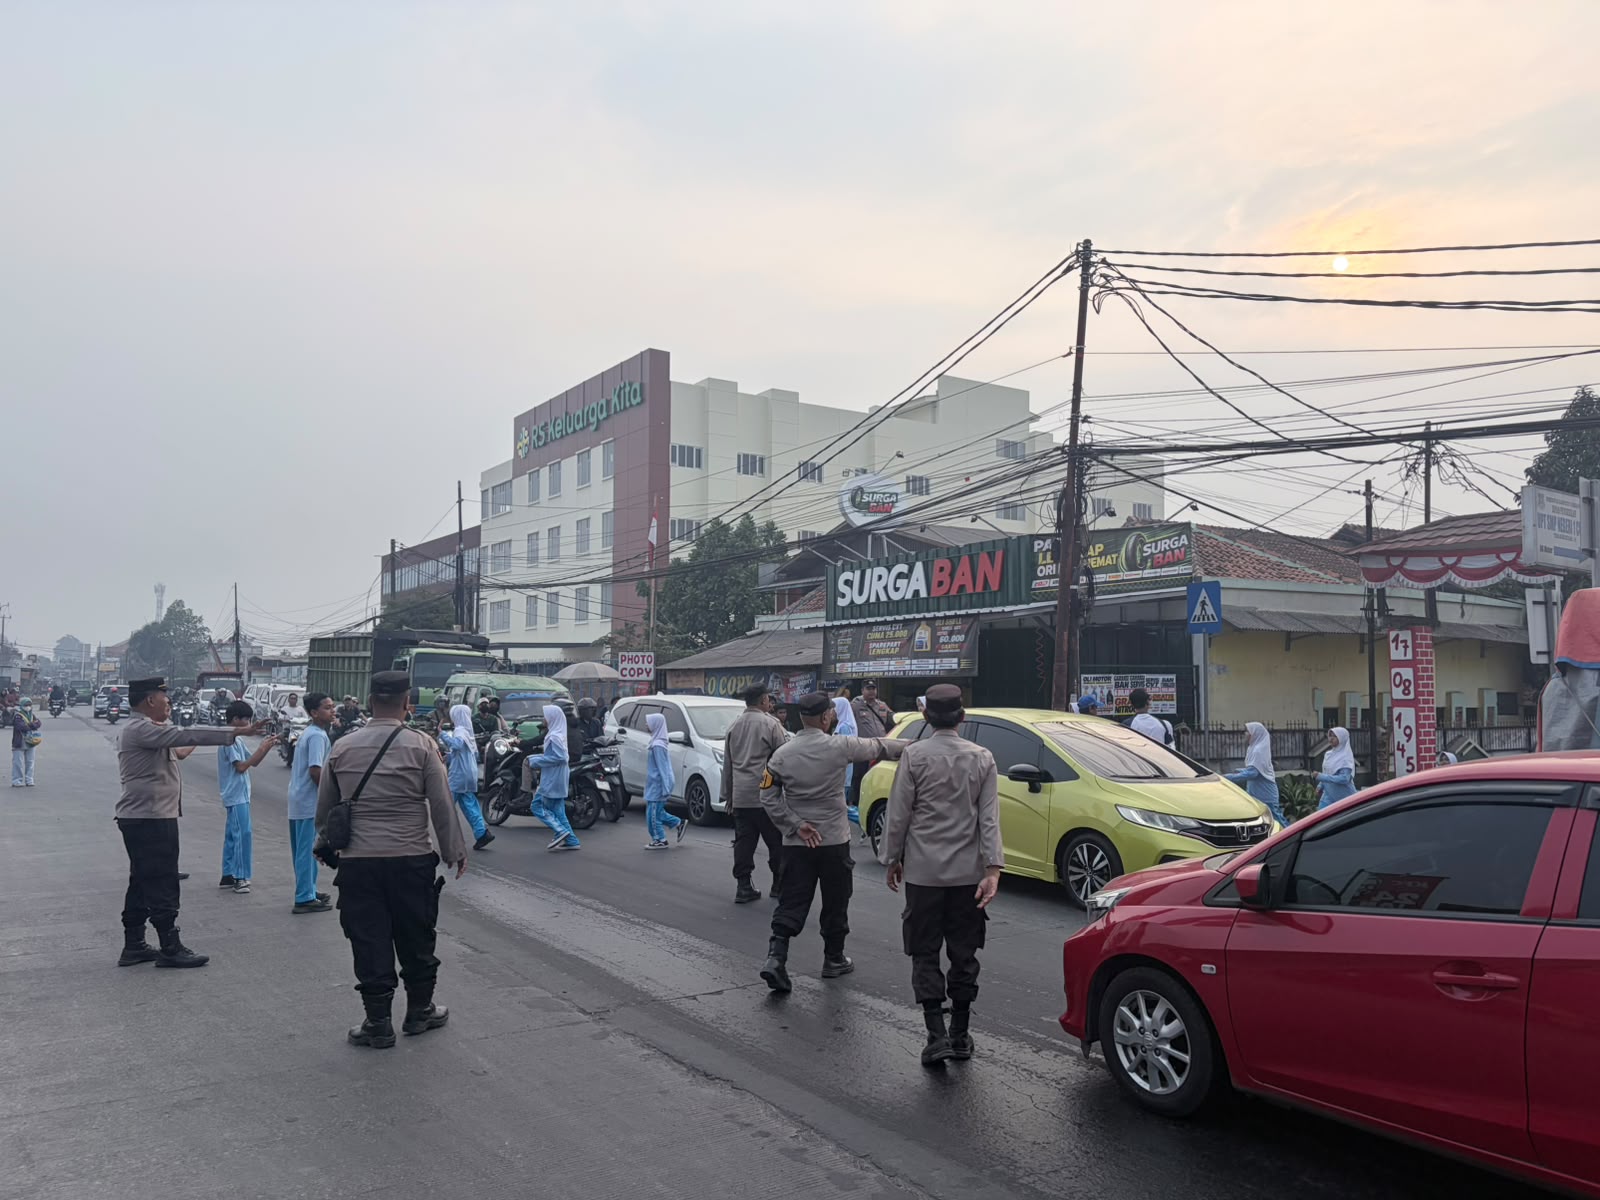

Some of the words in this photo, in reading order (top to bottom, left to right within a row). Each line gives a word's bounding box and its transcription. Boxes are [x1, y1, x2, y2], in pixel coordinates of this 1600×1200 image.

[531, 421, 548, 449] RS
[549, 398, 608, 442] Keluarga
[611, 380, 643, 415] Kita
[861, 493, 897, 502] SURGA
[869, 502, 893, 512] BAN
[1143, 534, 1189, 556] SURGA
[1153, 547, 1186, 568] BAN
[836, 561, 928, 607] SURGA
[930, 550, 1005, 597] BAN
[866, 631, 885, 639] CUMA
[1391, 632, 1409, 657] 17
[620, 654, 653, 665] PHOTO
[620, 667, 652, 678] COPY
[1392, 671, 1412, 696] 08
[1394, 711, 1415, 774] 1945
